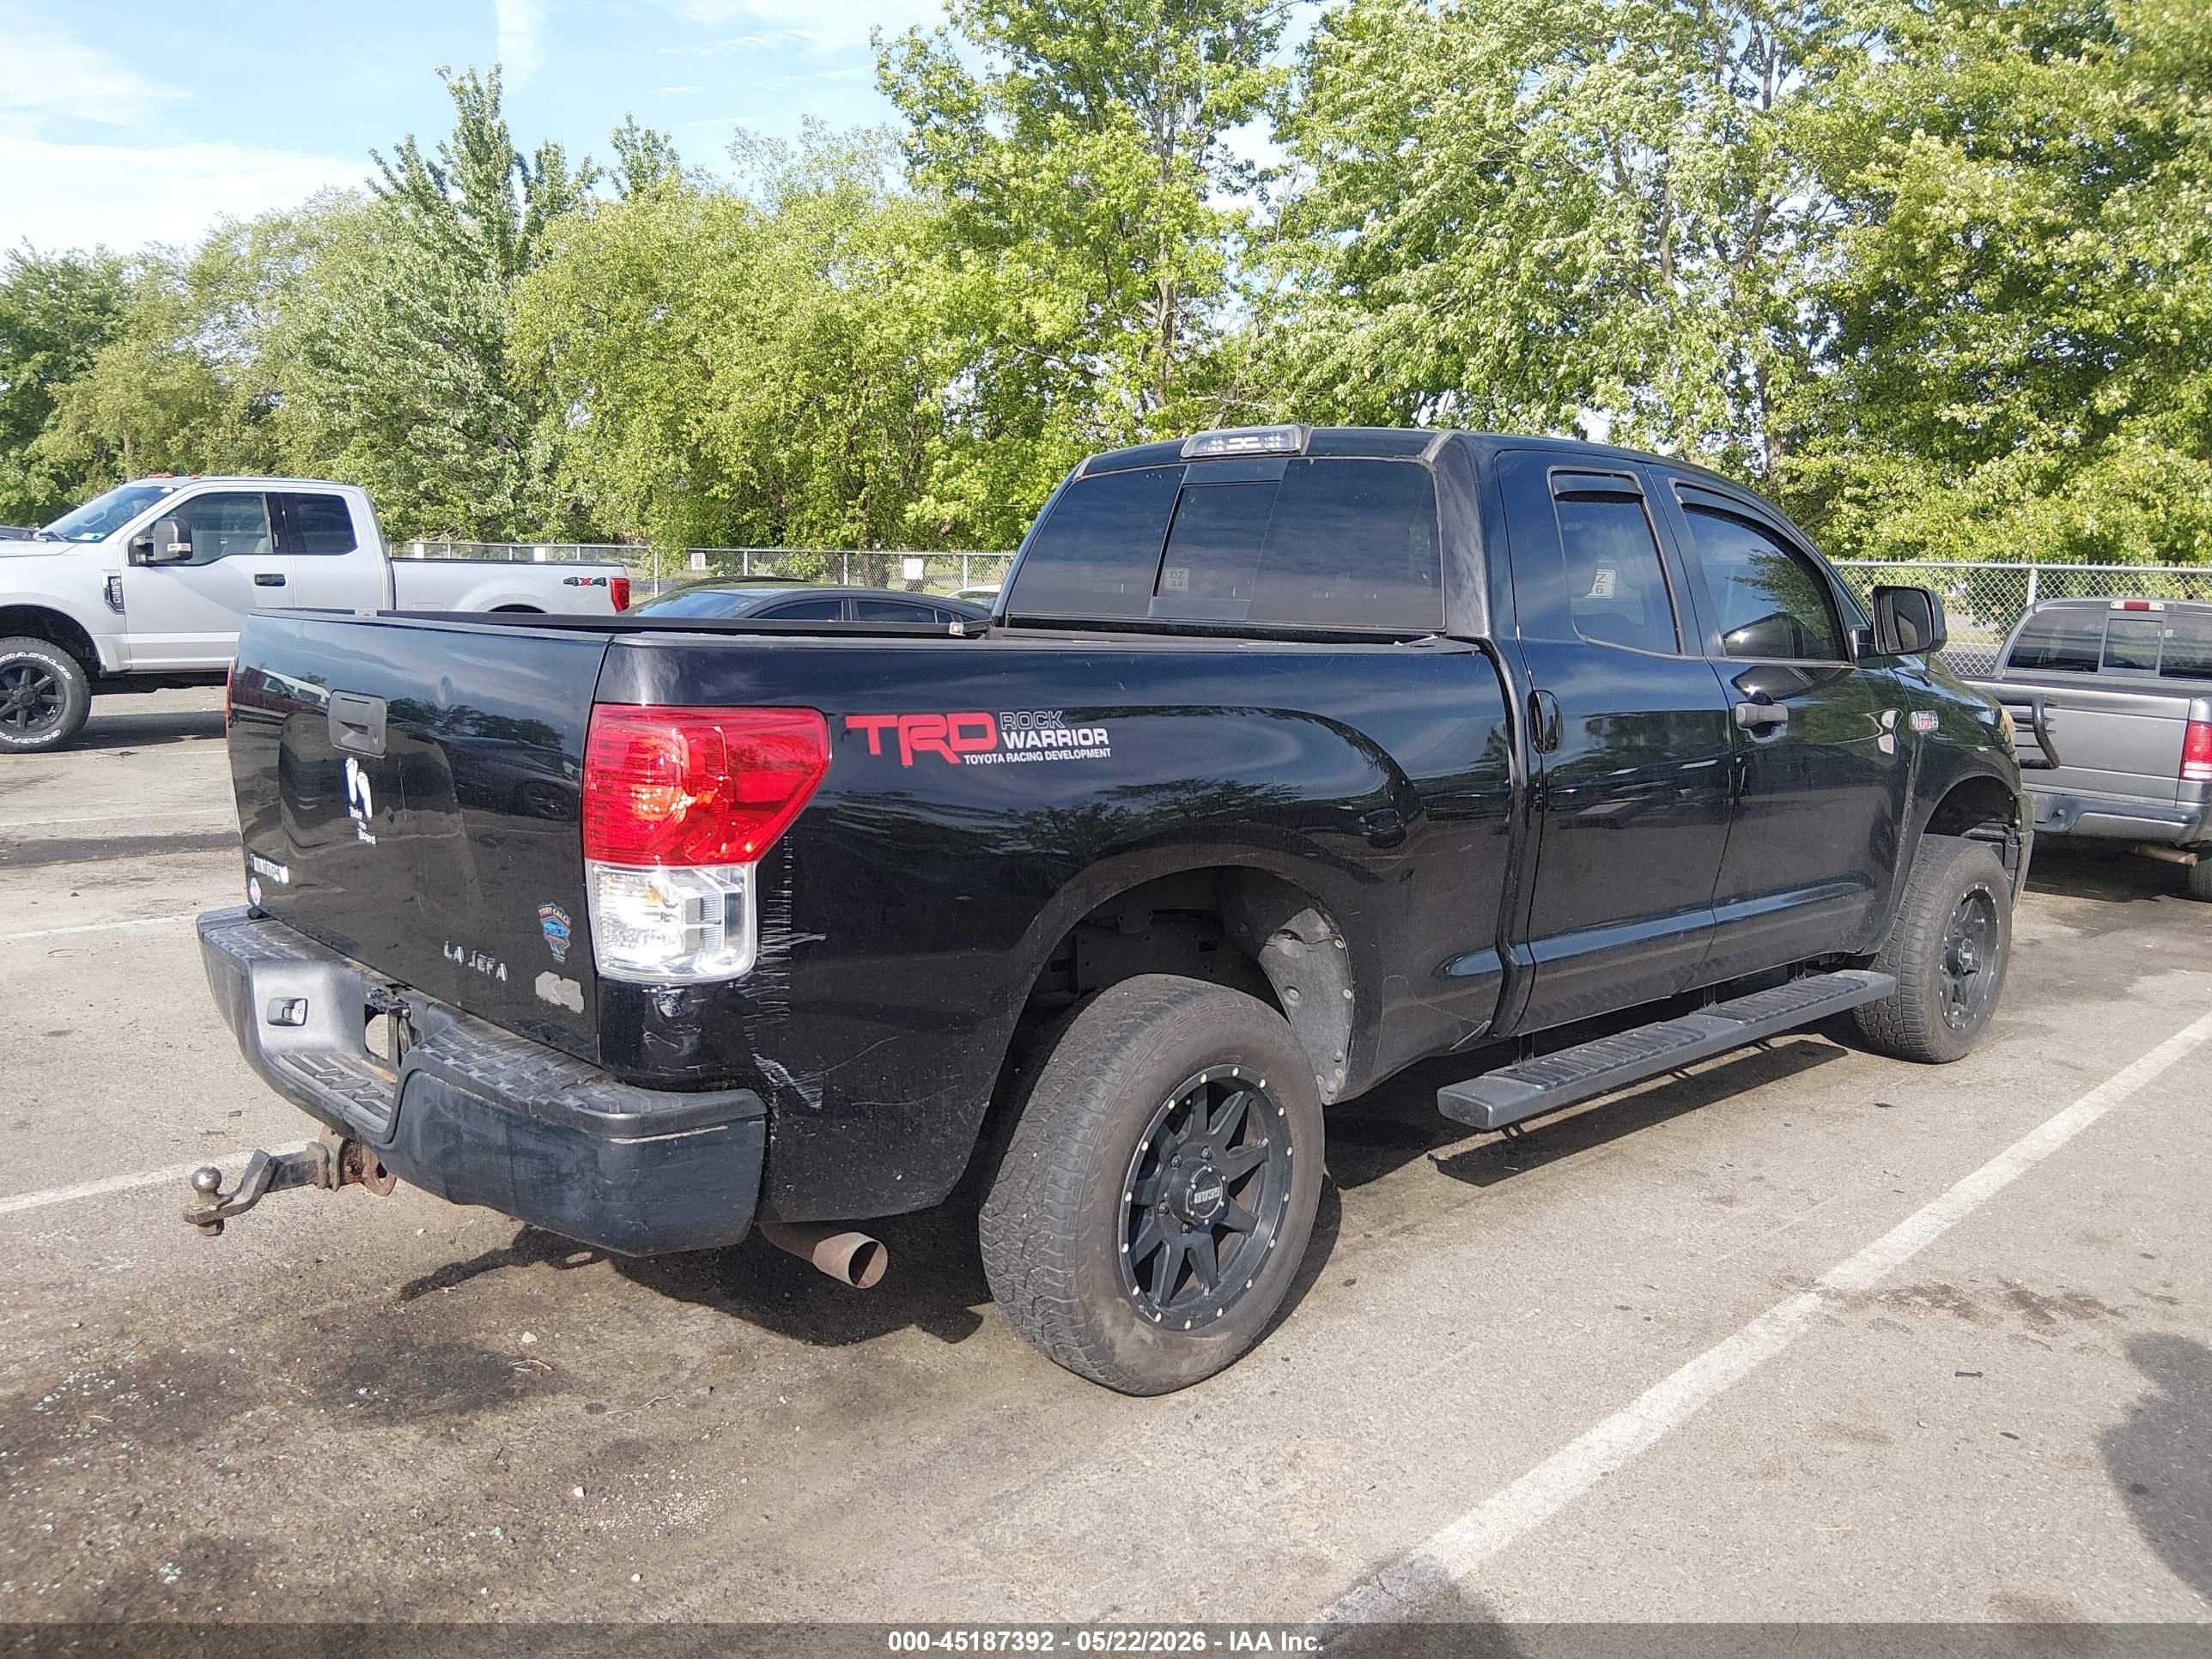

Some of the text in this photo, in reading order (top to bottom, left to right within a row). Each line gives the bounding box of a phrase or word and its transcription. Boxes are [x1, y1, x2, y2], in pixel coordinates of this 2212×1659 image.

[1170, 570, 1186, 580] DZ
[1000, 711, 1066, 730] ROCK
[844, 712, 999, 769] TRD
[1001, 728, 1110, 750] WARRIOR
[963, 748, 1112, 766] TOYOTA RACING DEVELOPMENT
[443, 940, 508, 981] LA JEFA
